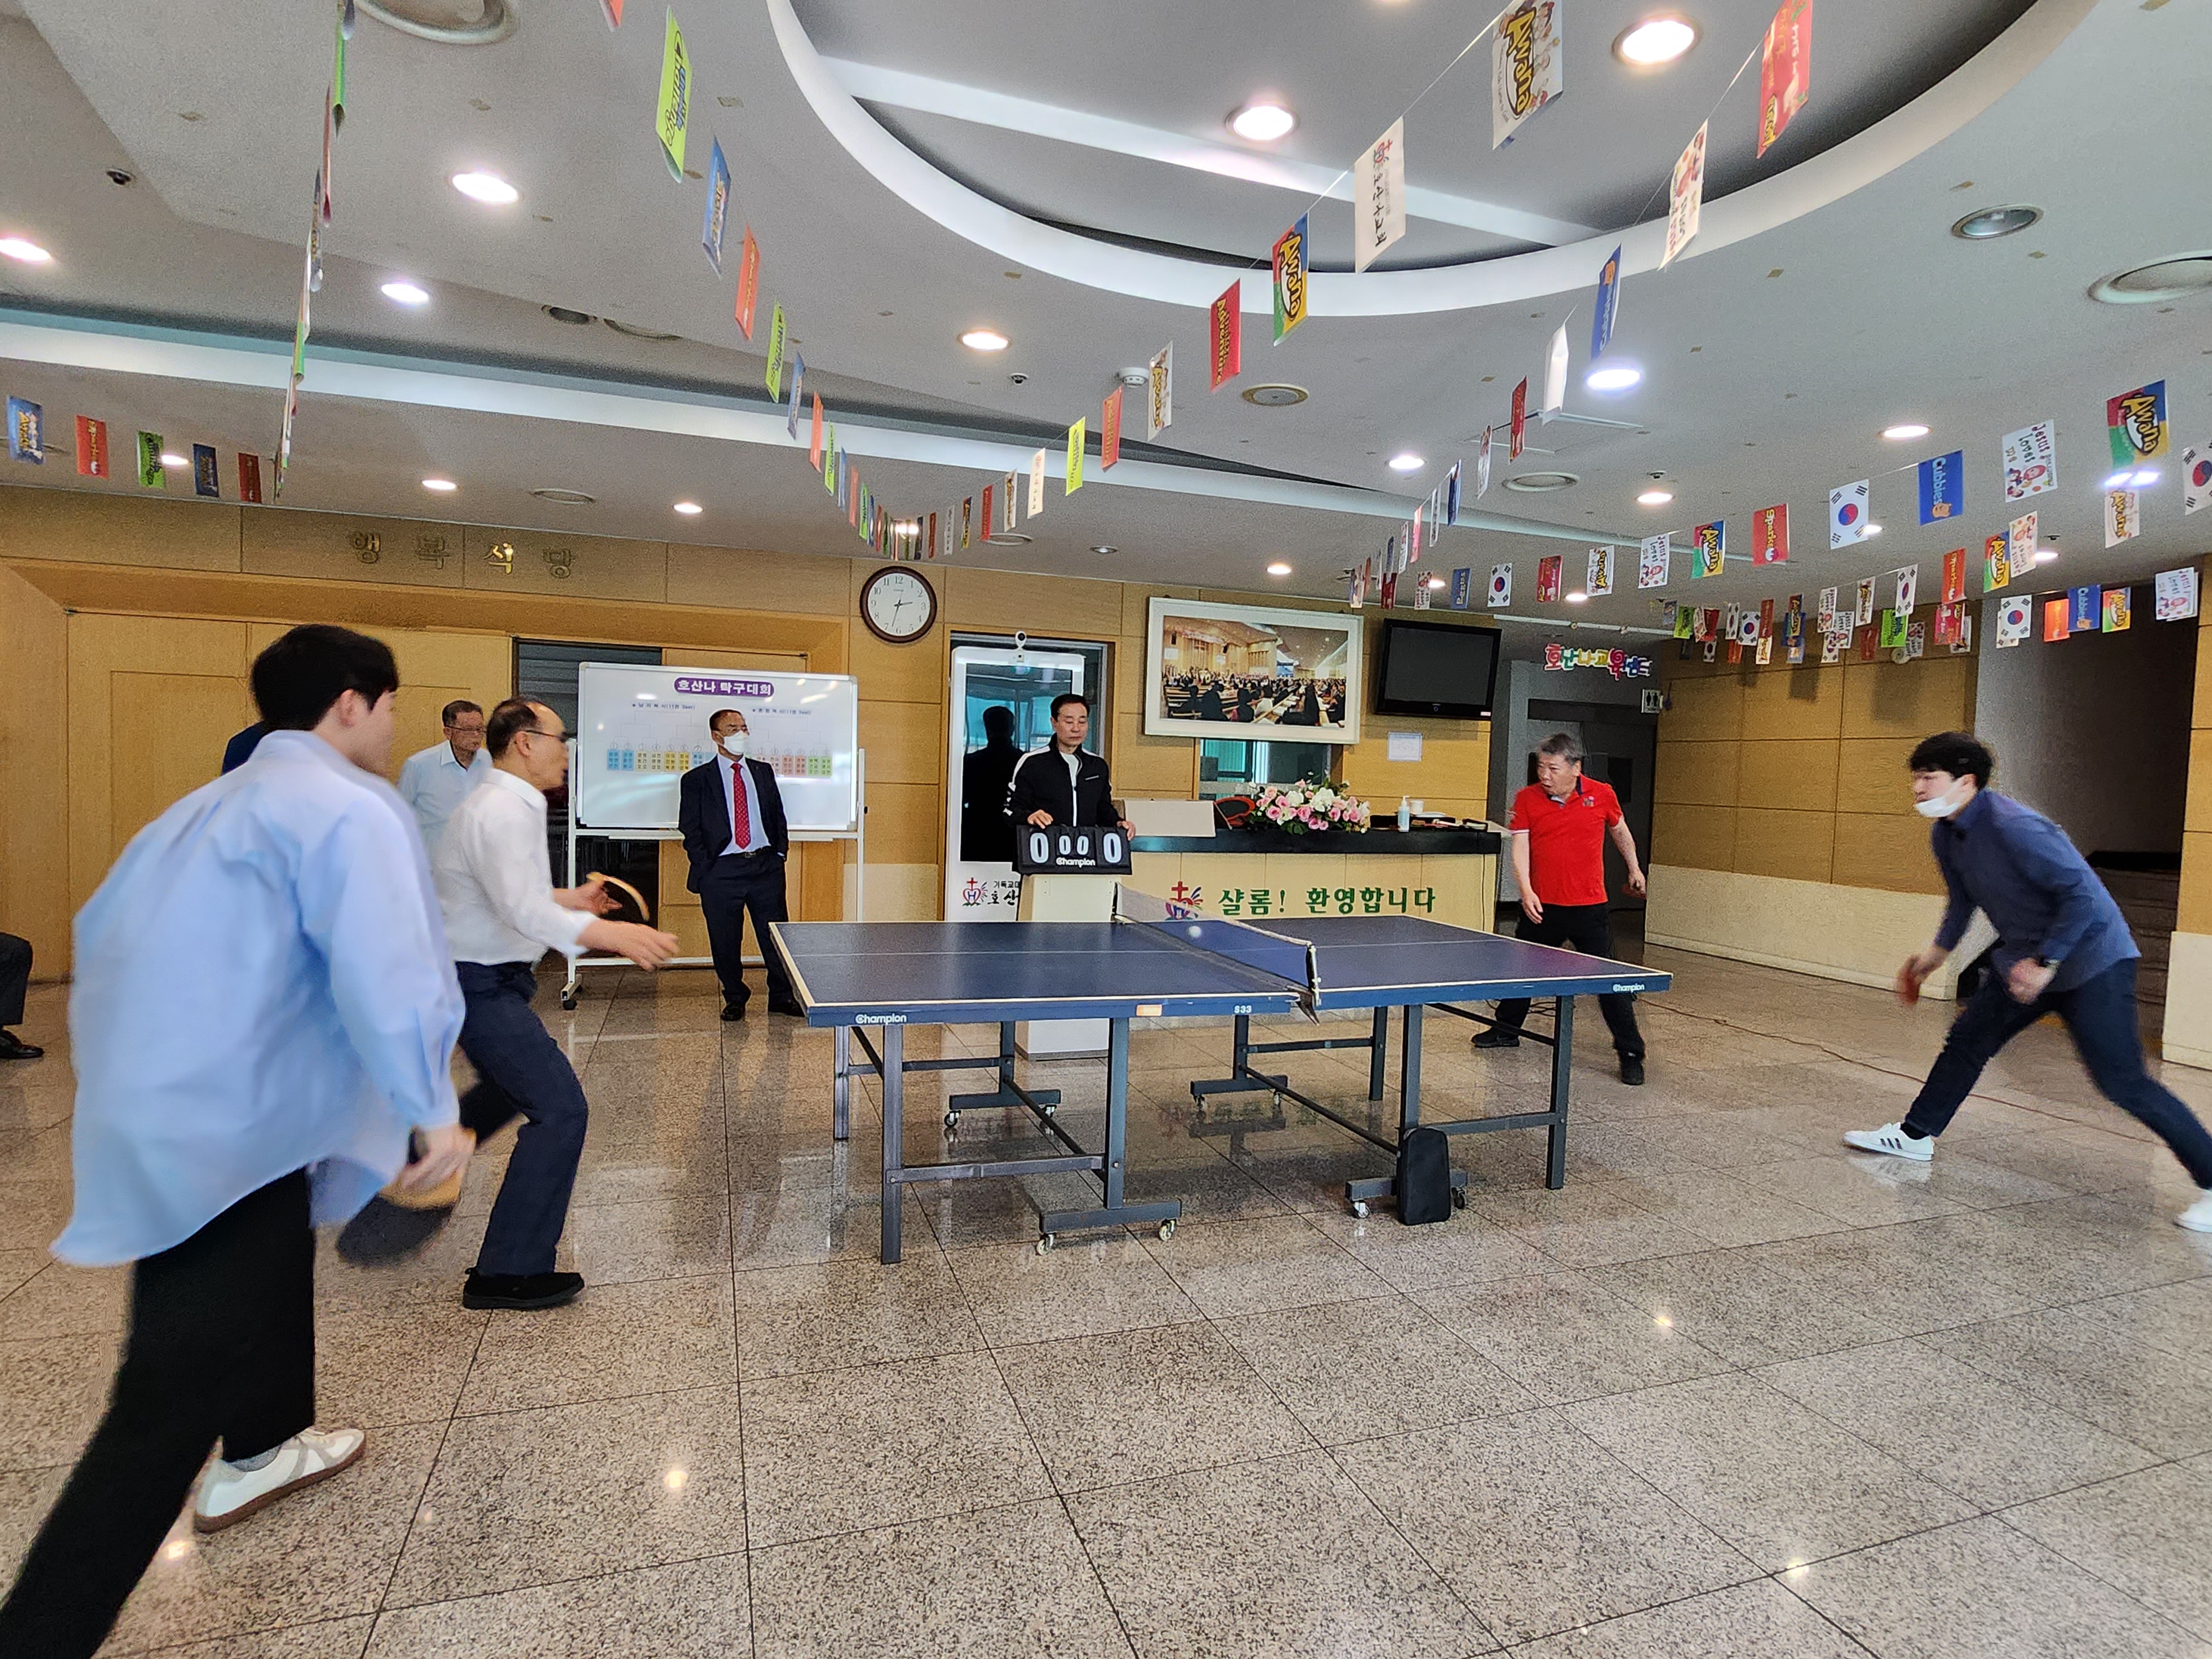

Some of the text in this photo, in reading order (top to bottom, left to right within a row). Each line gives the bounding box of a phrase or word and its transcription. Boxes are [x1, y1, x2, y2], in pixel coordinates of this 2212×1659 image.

[1504, 7, 1536, 115] Awana
[1278, 234, 1302, 322] Awana
[1215, 298, 1227, 386] Adventure
[1152, 365, 1162, 429] Awana
[2031, 424, 2051, 452] Jesus
[2120, 394, 2160, 456] Awana
[2005, 446, 2017, 463] me
[2018, 433, 2036, 463] loves
[1932, 457, 1947, 504] Cubbies
[1765, 508, 1777, 549] Sparks
[2110, 491, 2126, 537] Awana
[1657, 536, 1666, 558] Jesus
[1702, 528, 1719, 571] Awana
[1991, 539, 2006, 583] Awana
[1595, 550, 1608, 589] Awana
[871, 599, 876, 608] 9
[874, 587, 881, 595] 10
[917, 589, 923, 597] 2
[2077, 587, 2089, 619] Cubbies
[2110, 592, 2126, 626] Awana
[896, 626, 901, 634] 6
[909, 624, 914, 632] 5
[677, 680, 771, 696] 호산나 탁구대회
[1030, 832, 1122, 864] 0 0 0 0
[1056, 857, 1096, 868] Champion
[1218, 886, 1436, 916] 샬롬! 환영합니다
[1613, 983, 1645, 993] Champion
[855, 1013, 907, 1024] Champion
